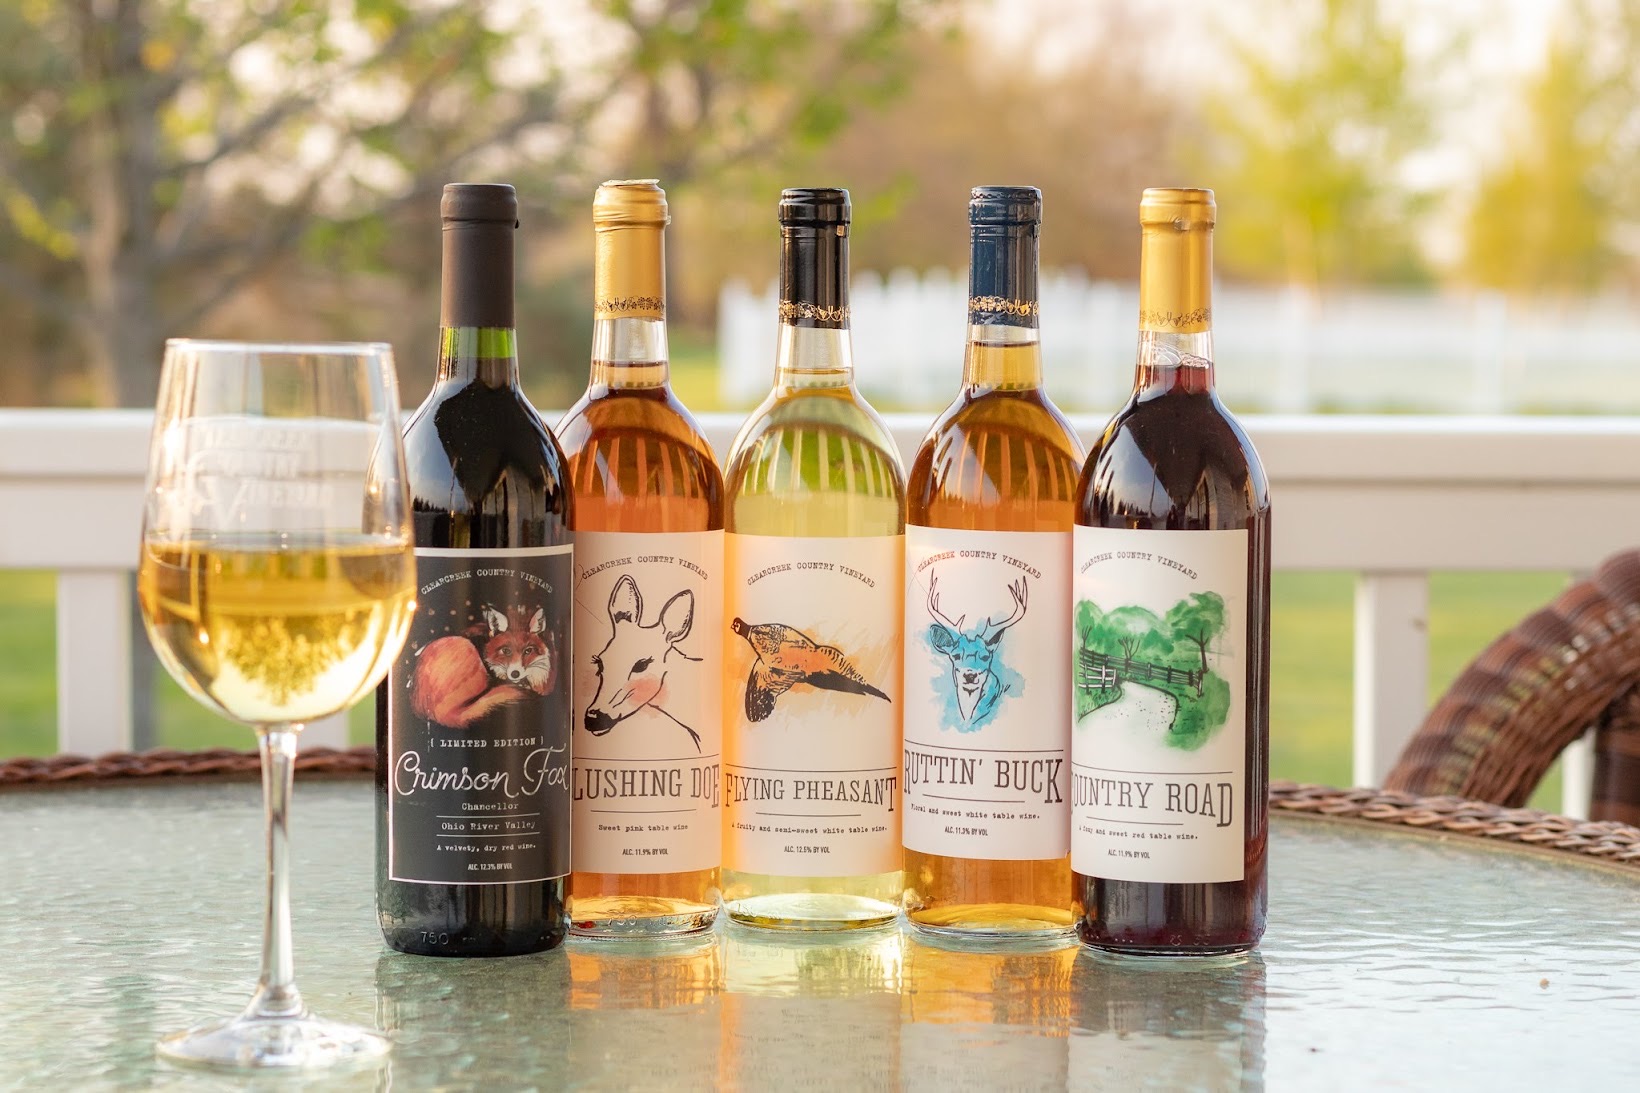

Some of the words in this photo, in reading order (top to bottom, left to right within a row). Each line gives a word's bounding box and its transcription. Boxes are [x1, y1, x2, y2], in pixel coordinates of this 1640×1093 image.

[582, 557, 632, 580] CLEARCREEK
[637, 555, 674, 564] COUNTRY
[678, 558, 708, 580] VINEYARD
[917, 550, 955, 572] CLEARCREEK
[959, 550, 998, 560] COUNTRY
[1002, 554, 1042, 580] VINEYARD
[1116, 551, 1152, 561] COUNTRY
[1157, 555, 1198, 580] VINEYARD
[421, 570, 472, 595] CLEARCREEK
[477, 568, 515, 577] COUNTRY
[520, 571, 553, 594] VINEYARD
[747, 563, 792, 586] CLEARCREEK
[796, 562, 835, 571] COUNTRY
[839, 565, 876, 588] VINEYARD
[440, 739, 487, 748] LIMITED
[494, 738, 536, 747] EDITION
[394, 750, 519, 798] Crimson
[521, 743, 569, 796] Fox
[903, 748, 983, 794] RUTTIN'
[994, 758, 1063, 804] BUCK
[571, 767, 682, 801] LUSHING
[690, 763, 720, 808] DOE
[725, 772, 785, 808] FLYING
[793, 776, 897, 812] PHEASANT
[462, 802, 519, 811] Chancellor
[1071, 772, 1153, 812] OUNTRY
[1165, 782, 1233, 828] ROAD
[911, 803, 926, 813] Floral
[966, 811, 988, 819] white
[992, 812, 1015, 820] table
[442, 822, 465, 831] Ohio
[470, 822, 500, 830] River
[505, 821, 536, 830] Valley
[625, 824, 644, 833] pink
[736, 822, 756, 832] fruity
[774, 826, 818, 834] semi-sweet
[944, 826, 954, 834] ALC.
[971, 828, 978, 836] BY
[978, 828, 988, 836] VOL
[1149, 832, 1172, 840] table
[484, 844, 497, 853] dry
[622, 848, 634, 856] ALC.
[635, 848, 651, 856] 11.9%
[652, 848, 659, 856] BY
[796, 846, 812, 854] 12.5%
[813, 846, 820, 854] BY
[820, 846, 830, 854] VOL
[1107, 848, 1117, 857] ALC.
[1117, 849, 1133, 858] 11.9%
[1133, 851, 1140, 859] BY
[1140, 851, 1151, 859] VOL
[503, 862, 513, 870] VOL
[420, 931, 449, 945] 750
